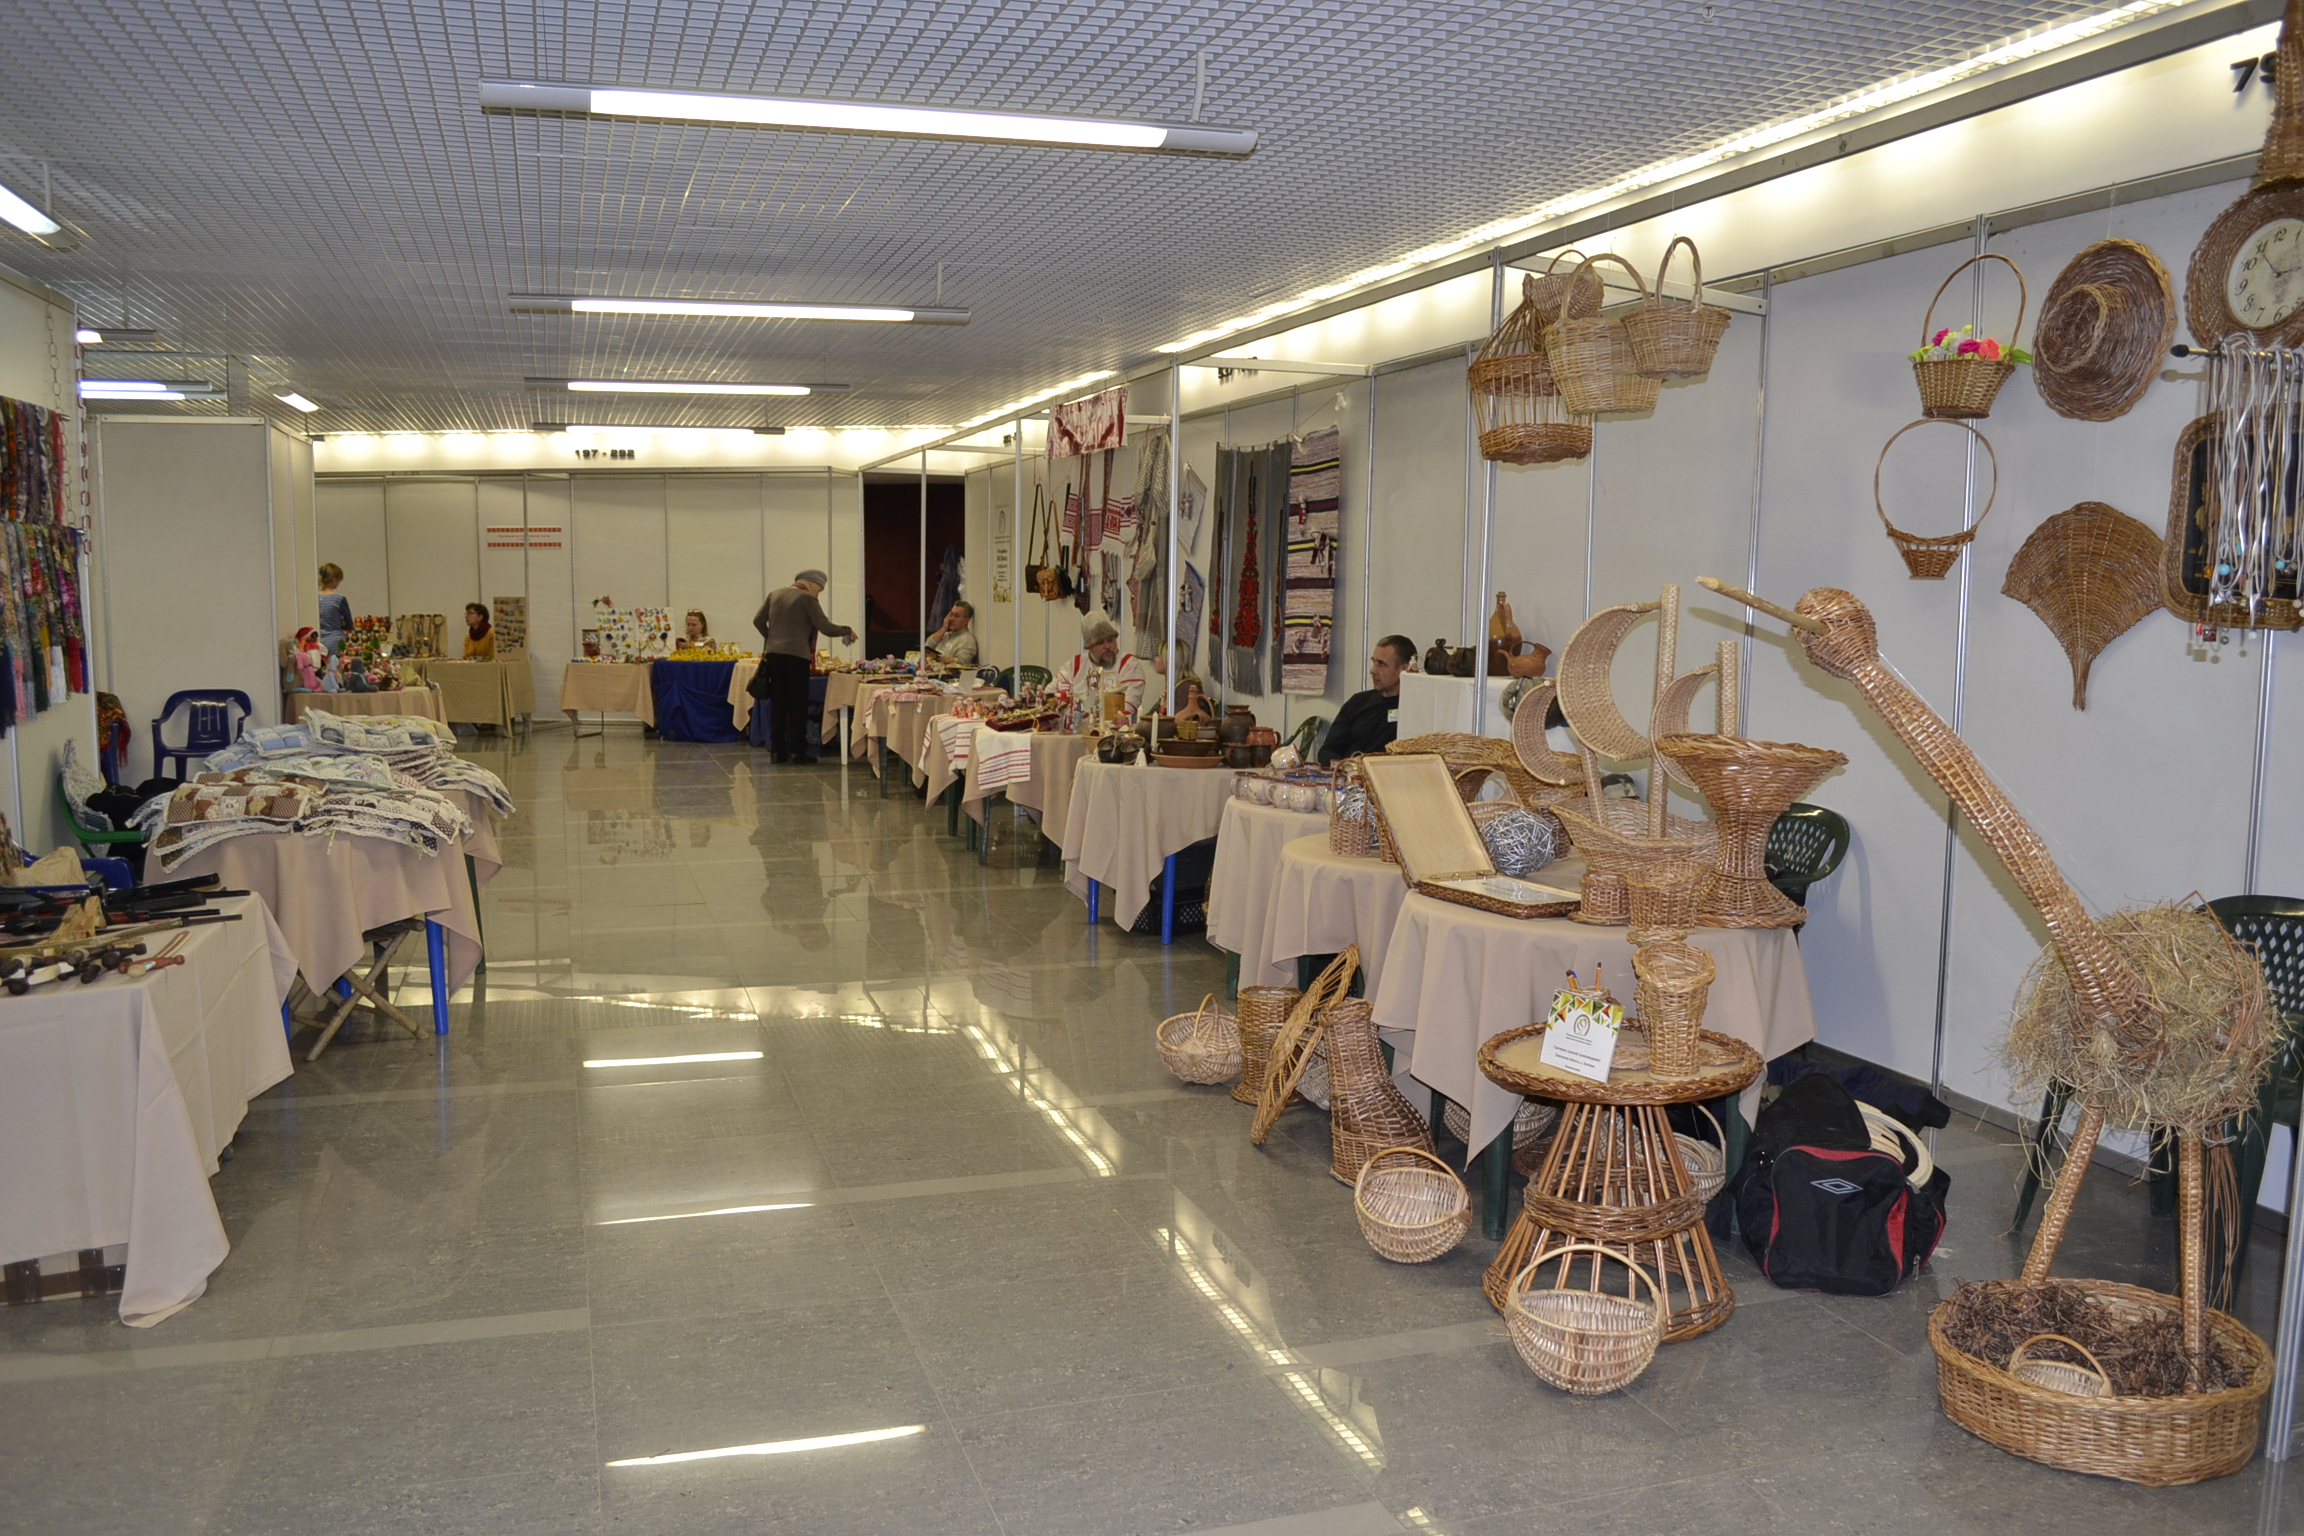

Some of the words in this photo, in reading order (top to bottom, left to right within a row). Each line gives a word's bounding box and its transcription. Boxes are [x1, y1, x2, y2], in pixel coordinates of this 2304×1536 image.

[2274, 227, 2287, 244] 12
[2294, 225, 2303, 242] 1
[2256, 239, 2269, 255] 11
[2242, 257, 2258, 272] 10
[2234, 278, 2249, 297] 9
[2243, 293, 2256, 312] 8
[2254, 306, 2265, 325] 7
[2273, 305, 2287, 324] 6
[575, 449, 598, 459] 197
